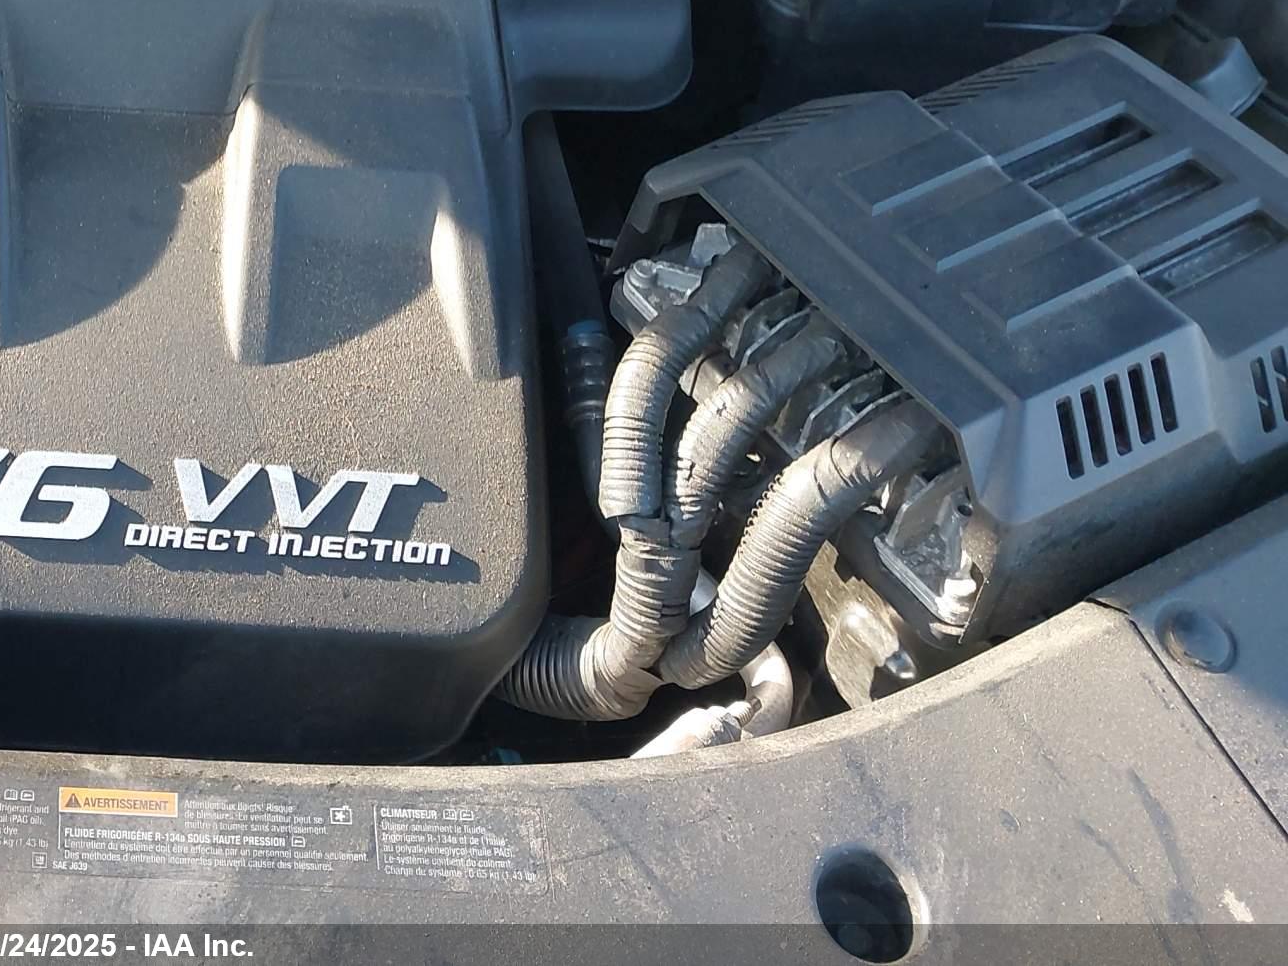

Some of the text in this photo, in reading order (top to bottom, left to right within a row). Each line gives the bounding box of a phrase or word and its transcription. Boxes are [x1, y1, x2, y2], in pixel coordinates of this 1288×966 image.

[173, 457, 420, 533] VVT
[124, 522, 451, 566] DIRECT INJECTION
[34, 805, 49, 815] and
[83, 797, 169, 811] AVERTISSEMENT
[380, 807, 437, 819] CLIMATISEUR
[64, 827, 94, 838] FLUIDE
[155, 832, 185, 843] R-134a
[187, 833, 210, 844] SOUS
[213, 834, 241, 845] HAUTE
[243, 835, 286, 847] PRESSION
[107, 842, 118, 851] du
[52, 860, 88, 871] SAE J639
